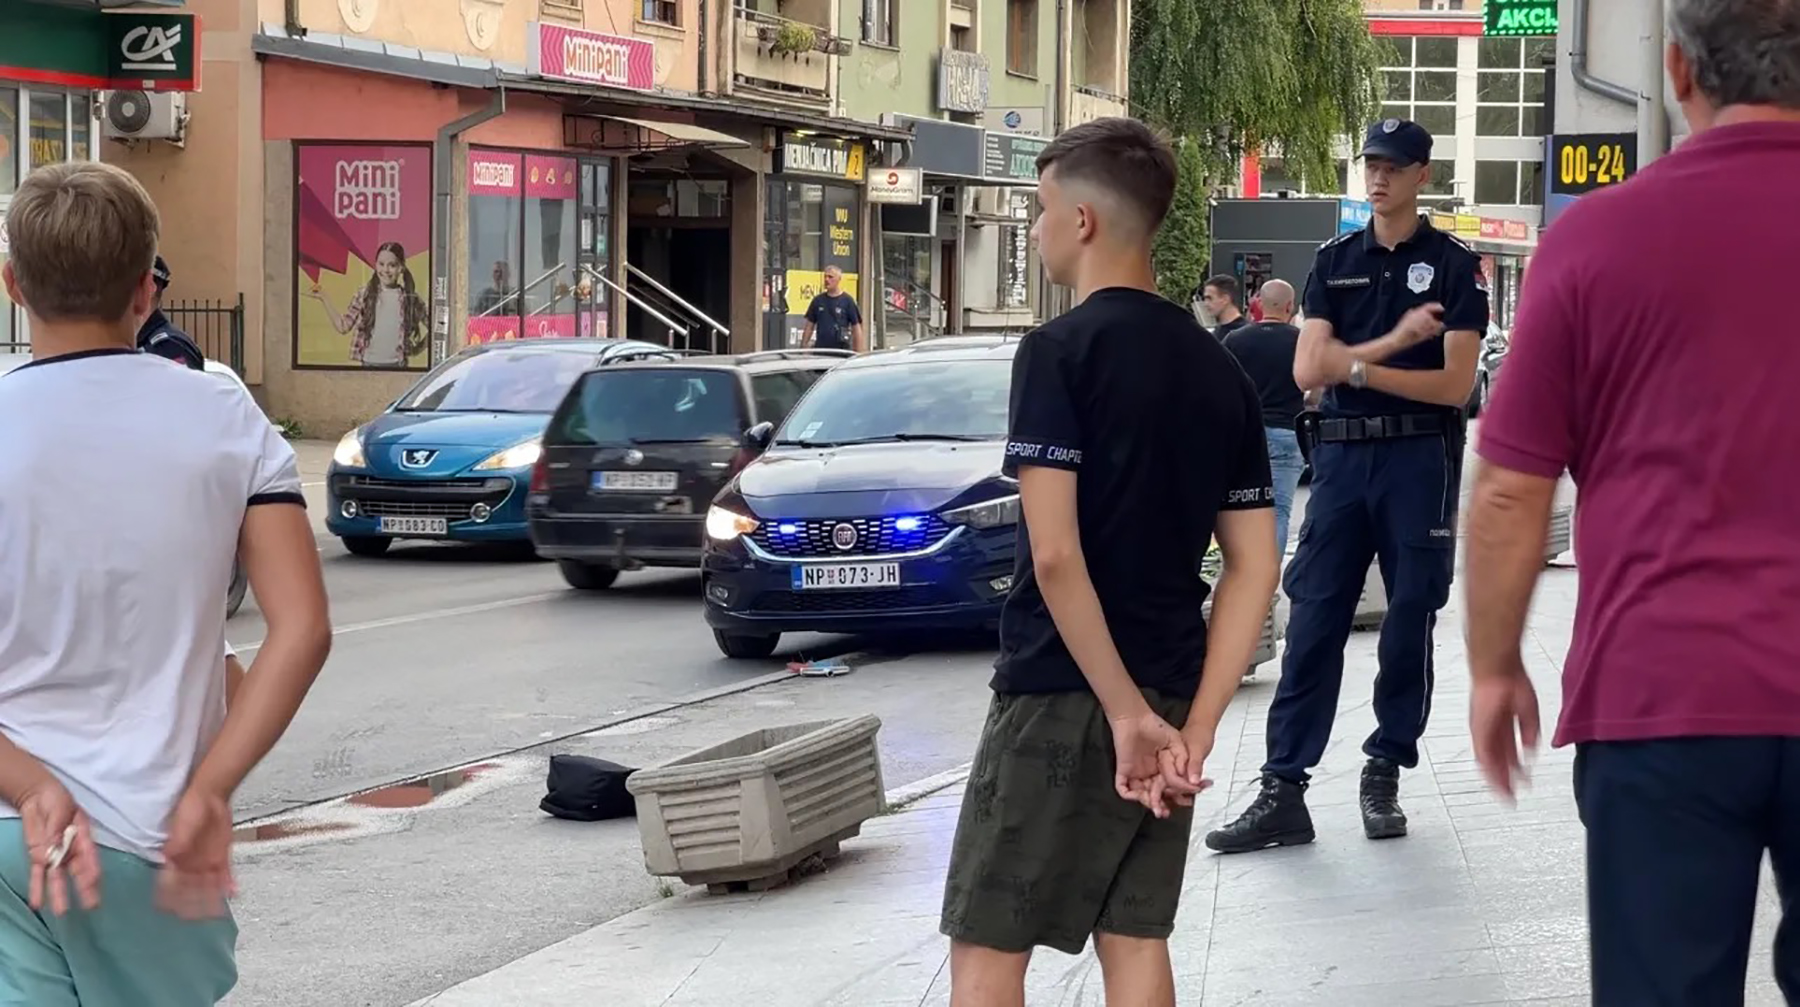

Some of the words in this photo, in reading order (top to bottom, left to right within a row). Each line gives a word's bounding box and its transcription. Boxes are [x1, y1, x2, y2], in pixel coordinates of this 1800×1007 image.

[564, 36, 629, 82] Minipani
[1561, 144, 1625, 184] 00-24
[336, 160, 400, 189] Mini
[870, 186, 914, 195] MoneyGram
[335, 190, 400, 219] pani
[1006, 442, 1042, 457] SPORT
[1228, 488, 1260, 502] SPORT
[383, 518, 397, 531] NP
[805, 567, 825, 585] NP
